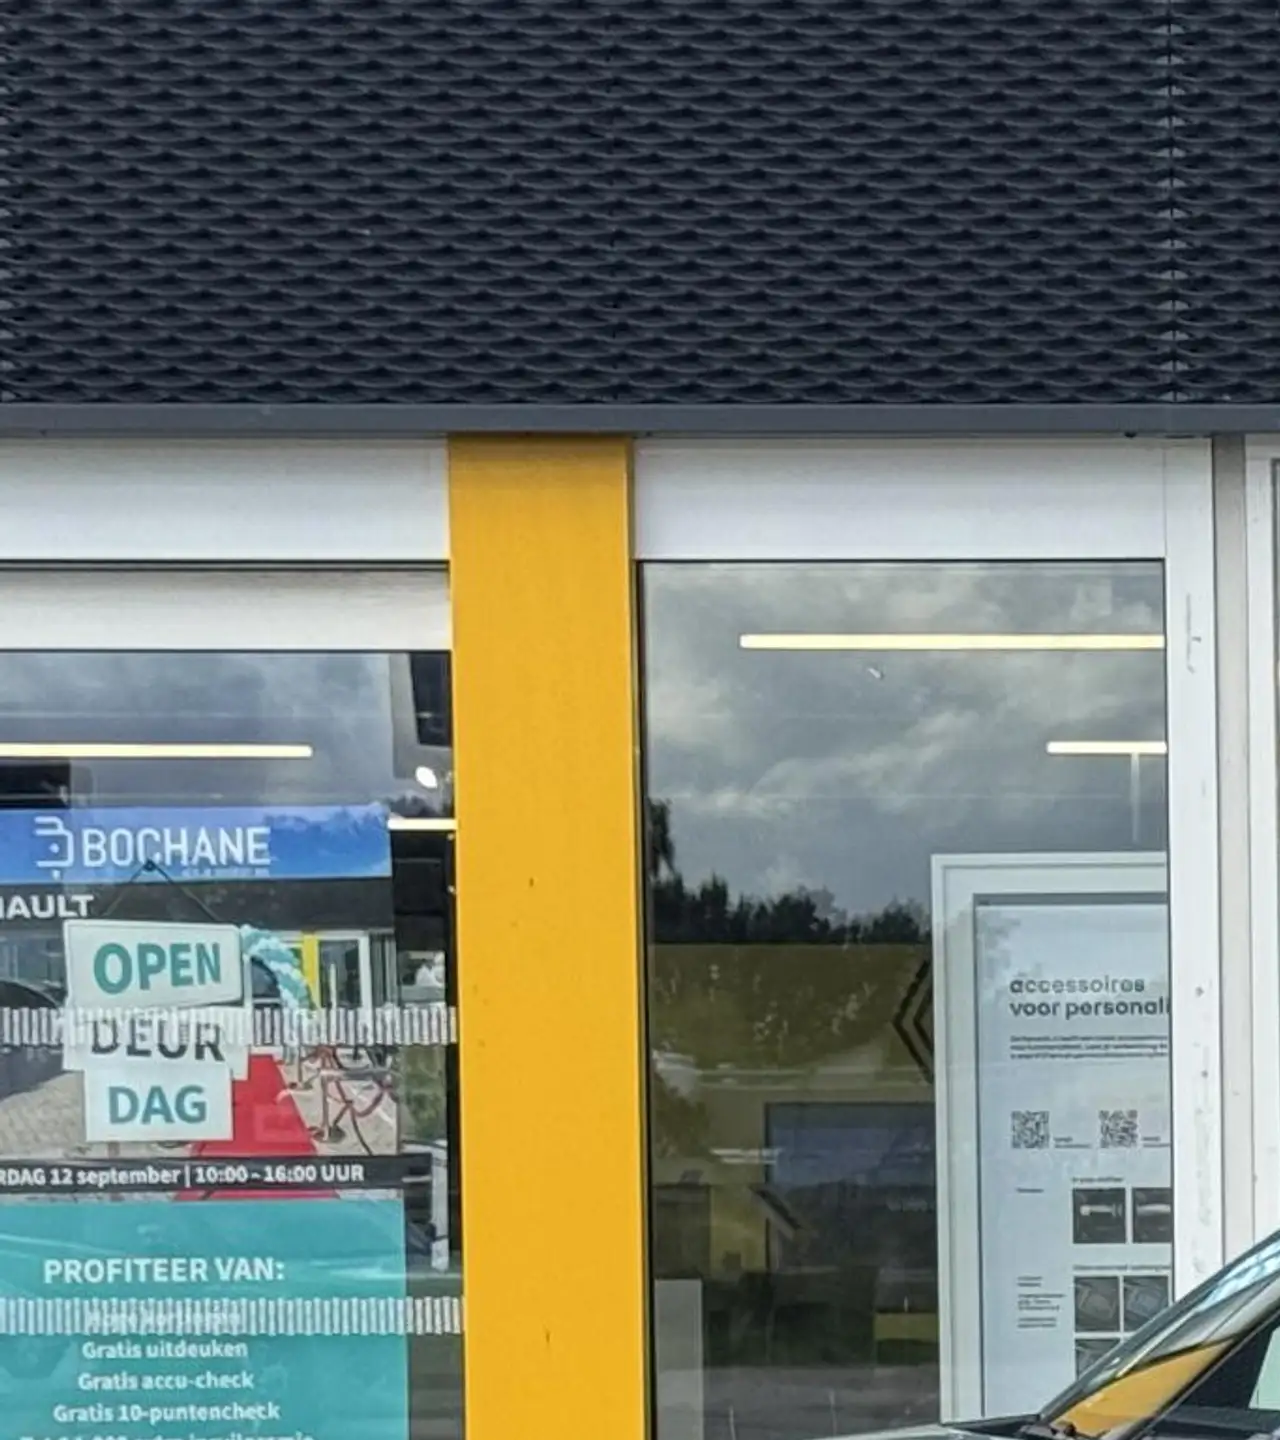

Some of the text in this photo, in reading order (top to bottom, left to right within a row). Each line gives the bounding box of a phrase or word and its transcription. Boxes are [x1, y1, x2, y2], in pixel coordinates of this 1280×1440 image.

[82, 827, 272, 868] BOCHANE
[0, 894, 94, 919] AULT
[93, 942, 222, 996] OPEN
[1009, 975, 1146, 995] accessoires
[1009, 1001, 1061, 1017] voor
[92, 1016, 226, 1063] DEUR
[108, 1084, 208, 1125] DAG
[50, 1167, 74, 1186] 12
[77, 1166, 182, 1188] september
[195, 1165, 249, 1184] 10:00
[264, 1164, 318, 1184] 16:00
[321, 1163, 365, 1182] UUR
[43, 1256, 286, 1284] PROFITEER VAN:
[82, 1339, 249, 1360] Gratis uitdeuken
[78, 1370, 255, 1391] Gratis accu-check
[53, 1401, 282, 1427] Gratis 10-puntencheck
